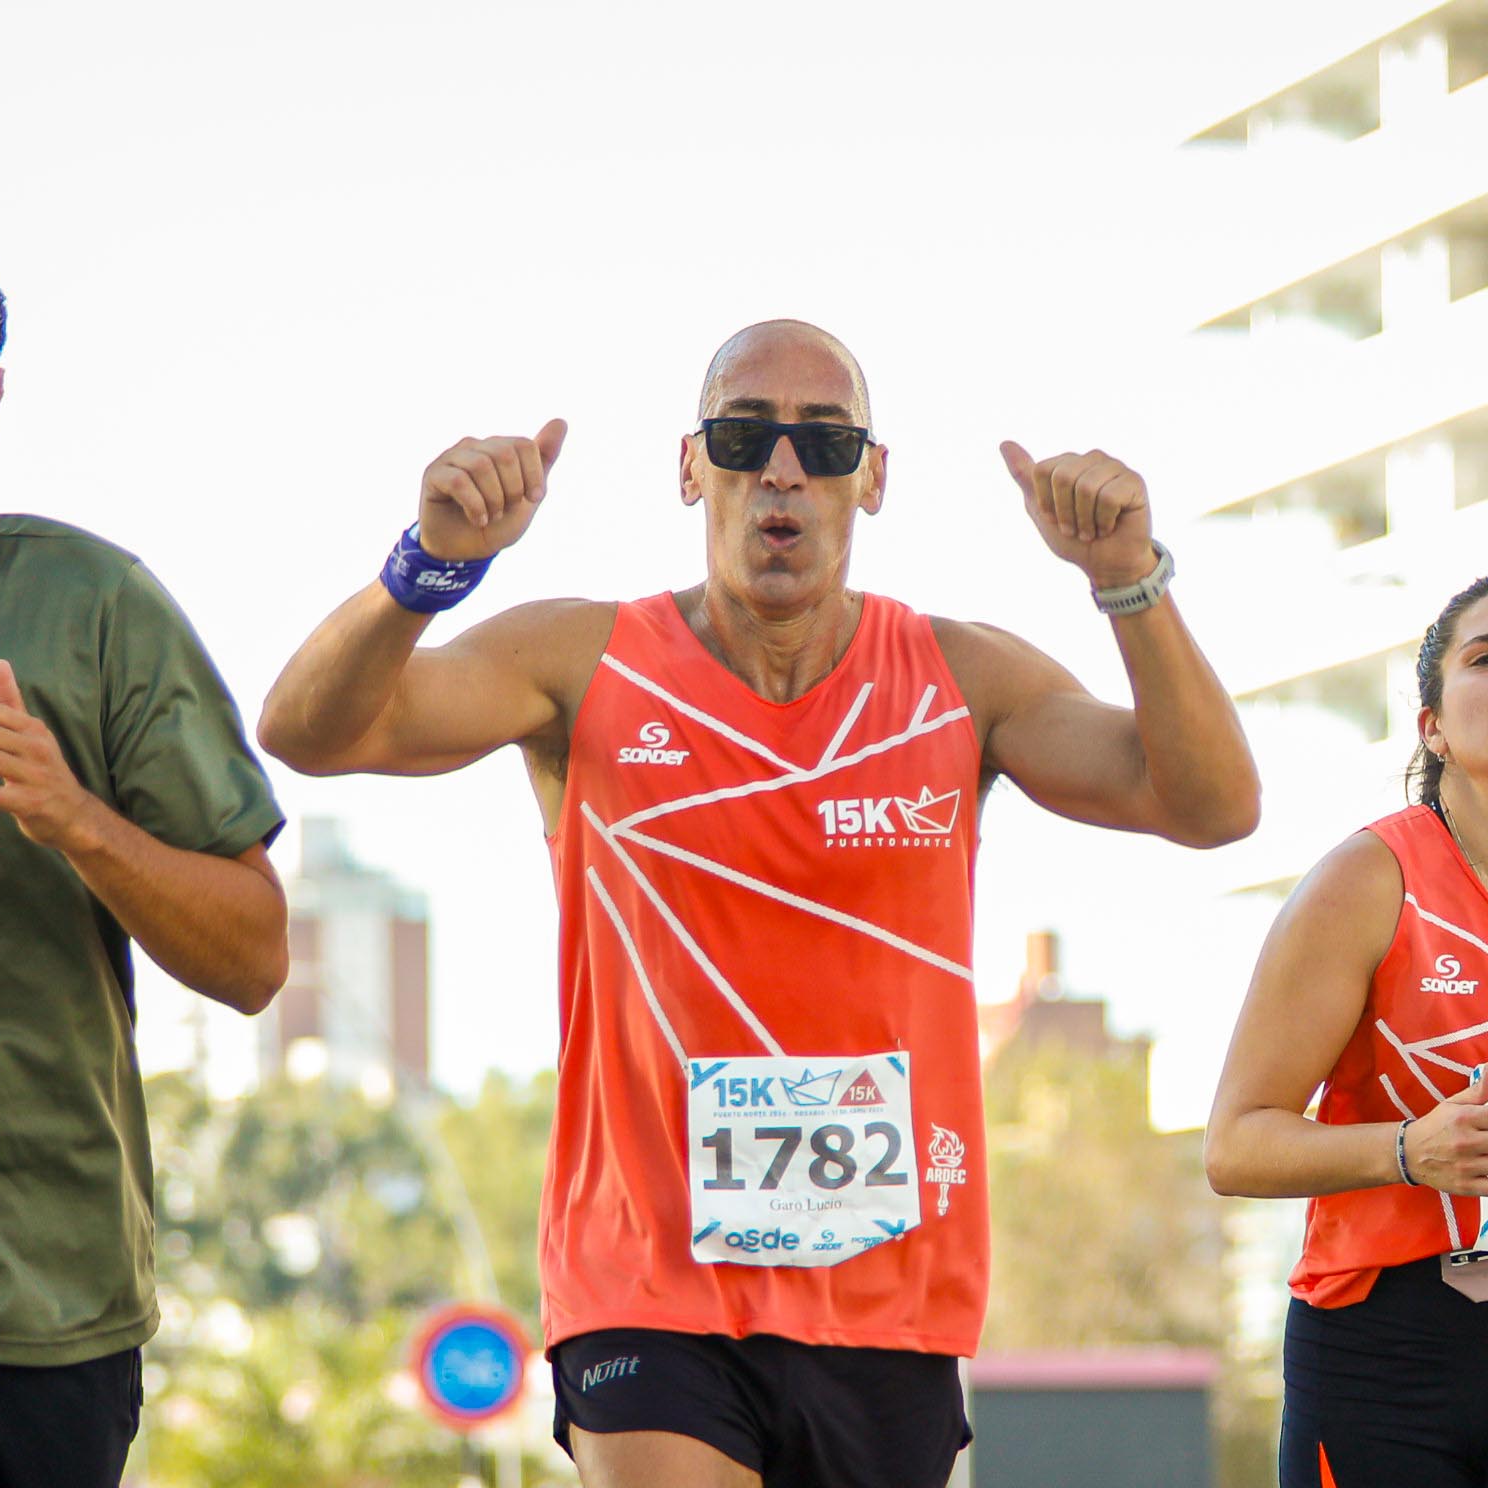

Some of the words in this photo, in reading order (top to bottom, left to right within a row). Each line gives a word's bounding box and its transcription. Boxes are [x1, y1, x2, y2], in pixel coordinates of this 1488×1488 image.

[818, 798, 896, 835] 15K
[712, 1077, 775, 1107] 15K
[848, 1086, 876, 1101] 15K
[701, 1121, 908, 1191] 1782
[925, 1167, 967, 1184] ARDEC
[769, 1199, 803, 1212] Garo
[724, 1226, 801, 1253] osde
